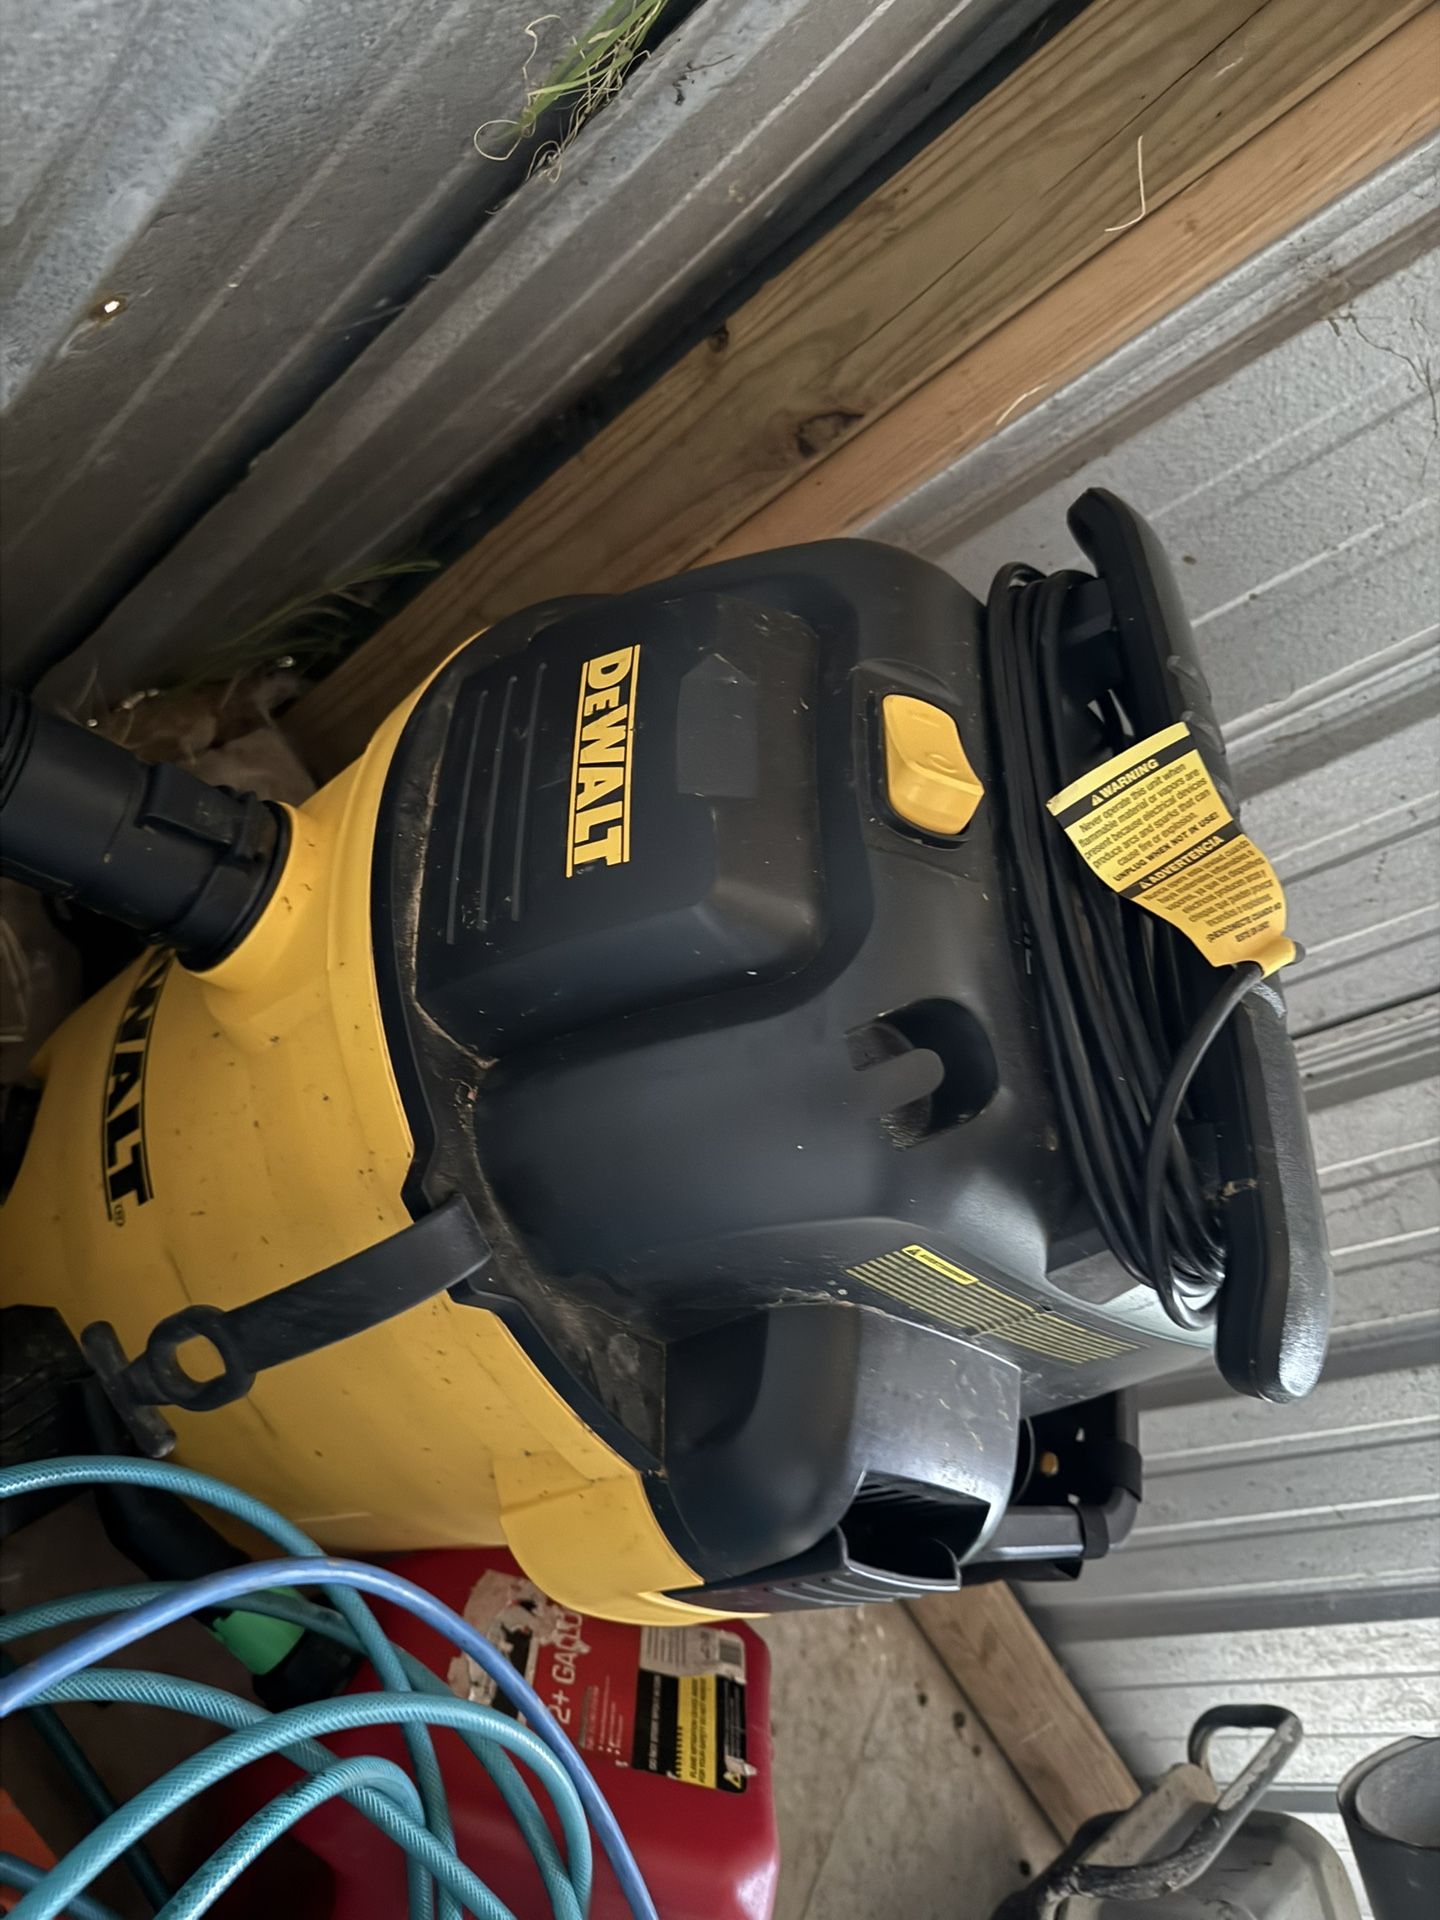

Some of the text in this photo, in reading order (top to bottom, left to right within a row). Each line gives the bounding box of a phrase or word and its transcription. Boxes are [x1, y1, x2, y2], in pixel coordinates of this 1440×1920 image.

[573, 645, 634, 866] DEWALT
[1098, 757, 1160, 799] WARNING
[1077, 768, 1200, 848] flammable material or vapors are
[1078, 762, 1186, 833] Never operate this unit when
[1081, 776, 1207, 860] present because electrical devices
[1091, 788, 1210, 869] produce arcs and sparks that can
[1113, 858, 1147, 882] UNPLUG
[1144, 842, 1171, 862] WHEN
[1170, 830, 1189, 846] NOT
[1188, 824, 1199, 834] IN
[1115, 847, 1140, 867] cause
[1137, 838, 1153, 852] fire
[1151, 833, 1161, 843] or
[1149, 834, 1224, 884] ADVERTENCIA
[107, 948, 171, 1206] WALT
